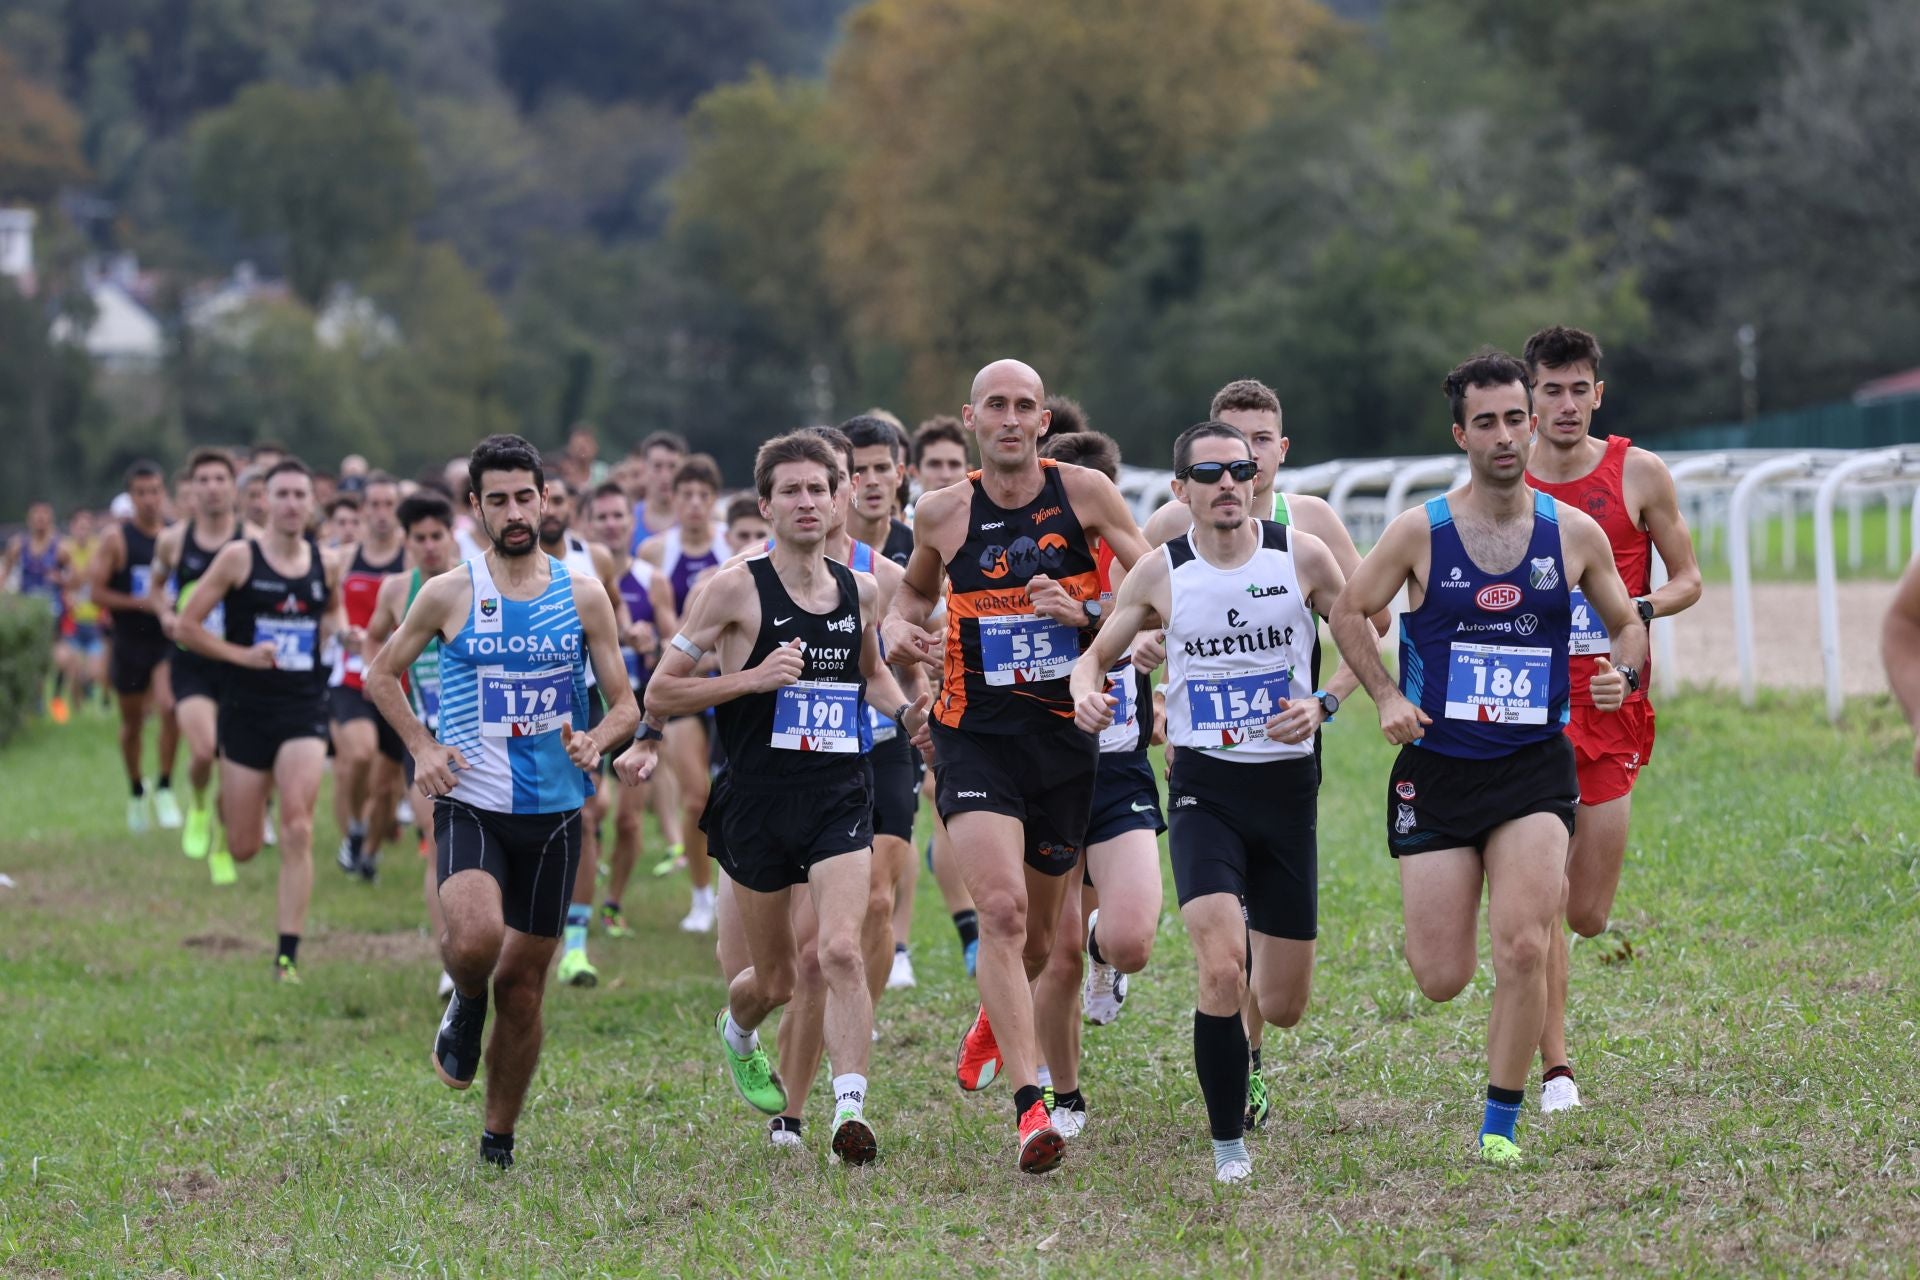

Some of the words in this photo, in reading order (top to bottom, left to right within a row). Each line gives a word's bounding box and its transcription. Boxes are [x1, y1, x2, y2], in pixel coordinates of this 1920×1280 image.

[1252, 585, 1288, 598] LUGA
[1484, 590, 1516, 604] JASO
[986, 628, 997, 636] 69
[1457, 621, 1511, 632] Autowag
[466, 634, 556, 655] TOLOSA
[561, 633, 578, 650] CF
[1012, 632, 1053, 660] 55
[1185, 625, 1294, 657] etxenike
[528, 651, 579, 662] ATLETISMO
[809, 648, 850, 660] VICKY
[1457, 655, 1469, 664] 69
[812, 661, 844, 670] FOODS
[998, 661, 1027, 671] DIEGO
[1030, 655, 1068, 667] PASCUAL
[489, 681, 499, 689] 69
[1194, 684, 1205, 692] 69
[1474, 666, 1532, 697] 186
[504, 687, 557, 714] 179
[784, 690, 794, 698] 69
[1210, 688, 1273, 720] 154
[1467, 695, 1505, 706] SAMUEL
[1507, 698, 1530, 707] VEGA
[501, 715, 530, 723] ANDER
[532, 710, 557, 721] GARIN
[797, 700, 843, 729] 190
[1197, 721, 1238, 730] ATARRATZE
[1240, 715, 1264, 727] BEÑAT
[786, 727, 811, 735] JAIRO
[813, 728, 846, 737] GRIJALVO
